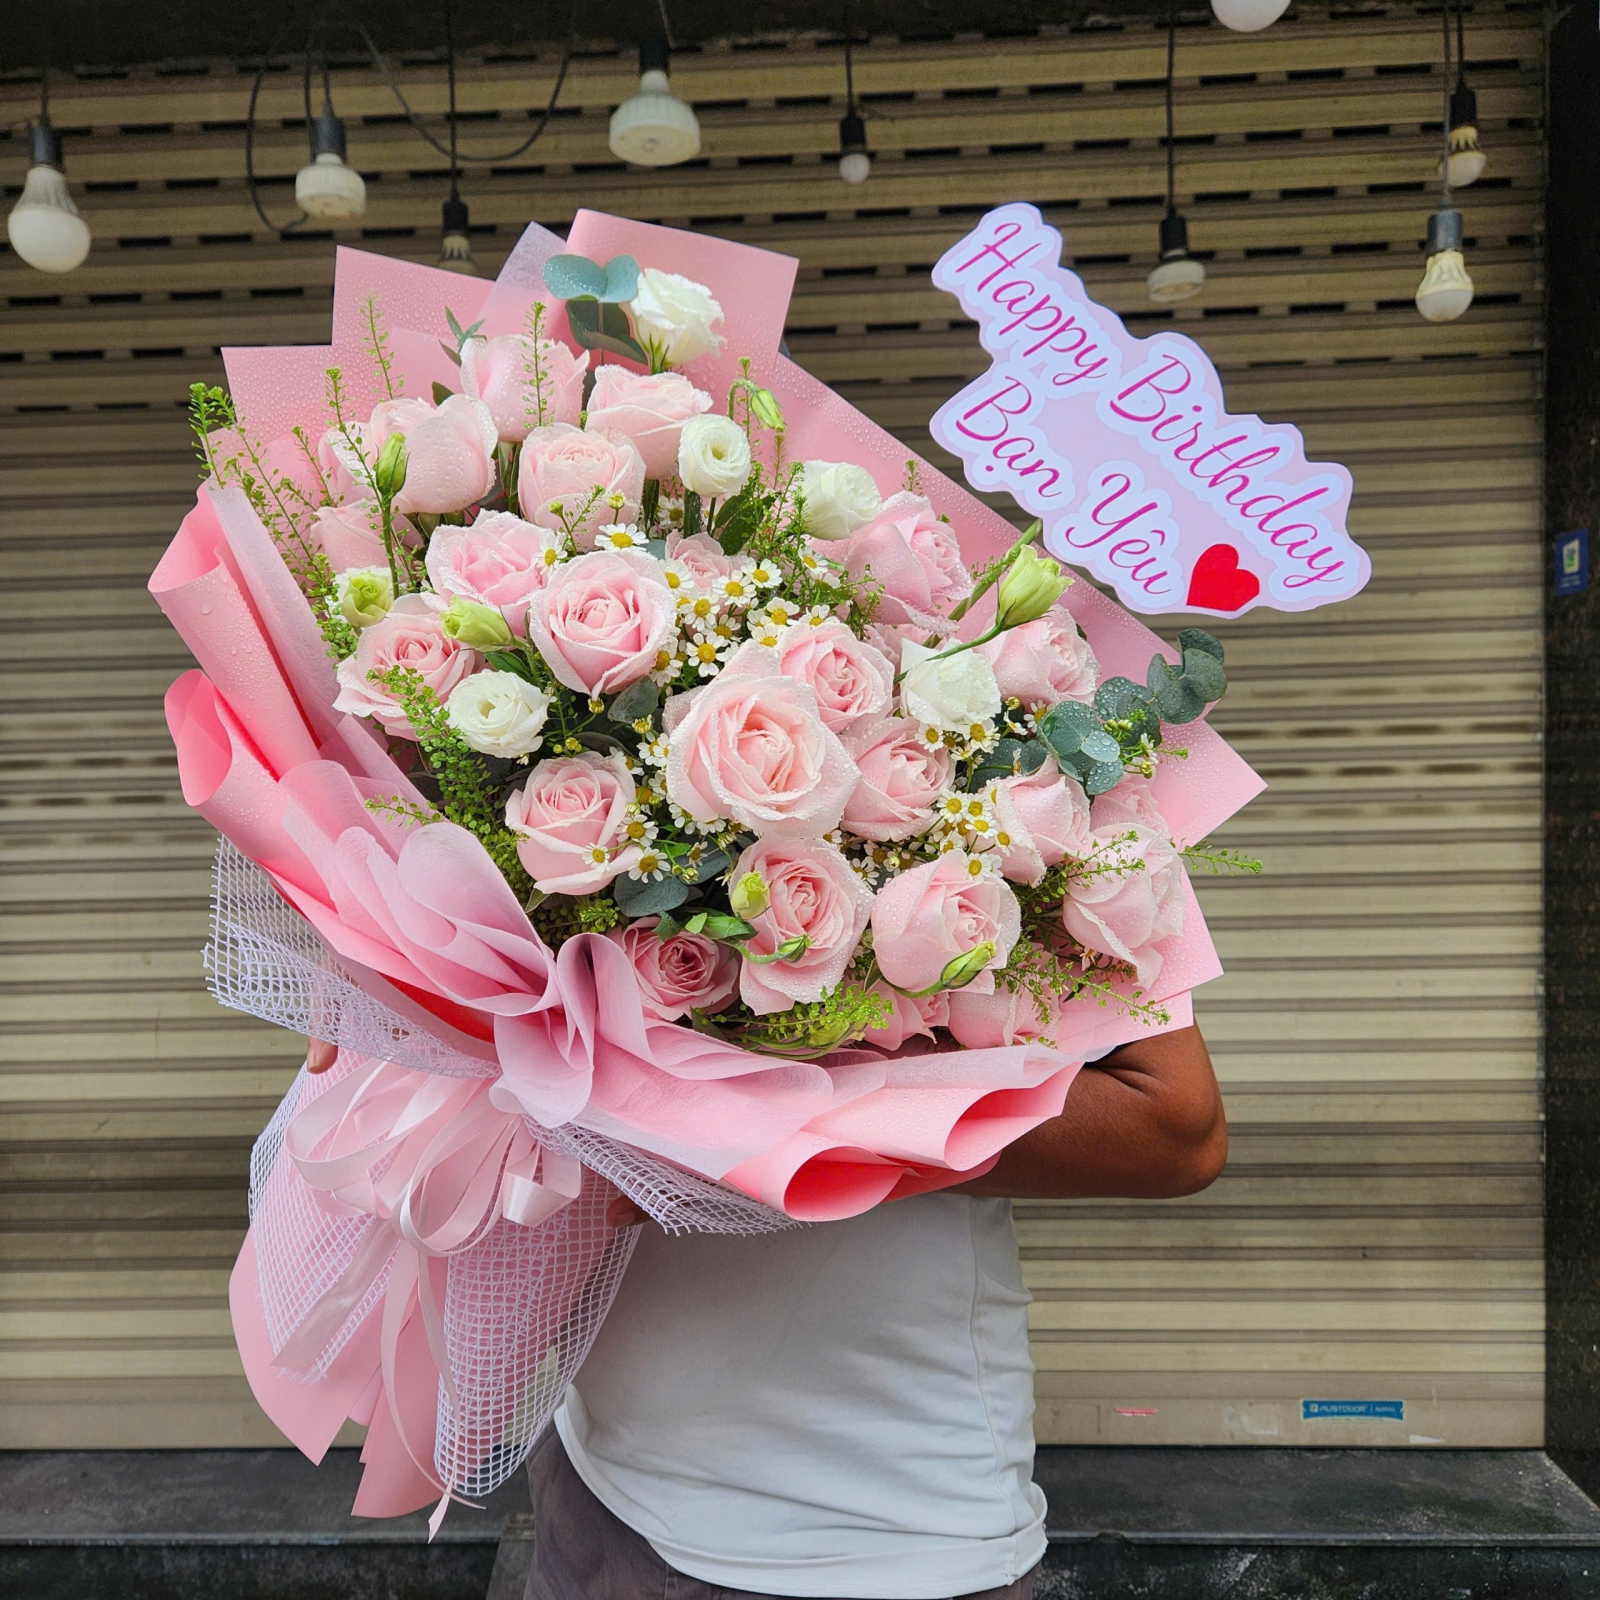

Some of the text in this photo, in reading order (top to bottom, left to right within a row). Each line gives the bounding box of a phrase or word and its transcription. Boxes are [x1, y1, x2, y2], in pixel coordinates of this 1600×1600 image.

[955, 222, 1344, 589] Happy Birthday
[955, 376, 1171, 595] Bạn Yêu
